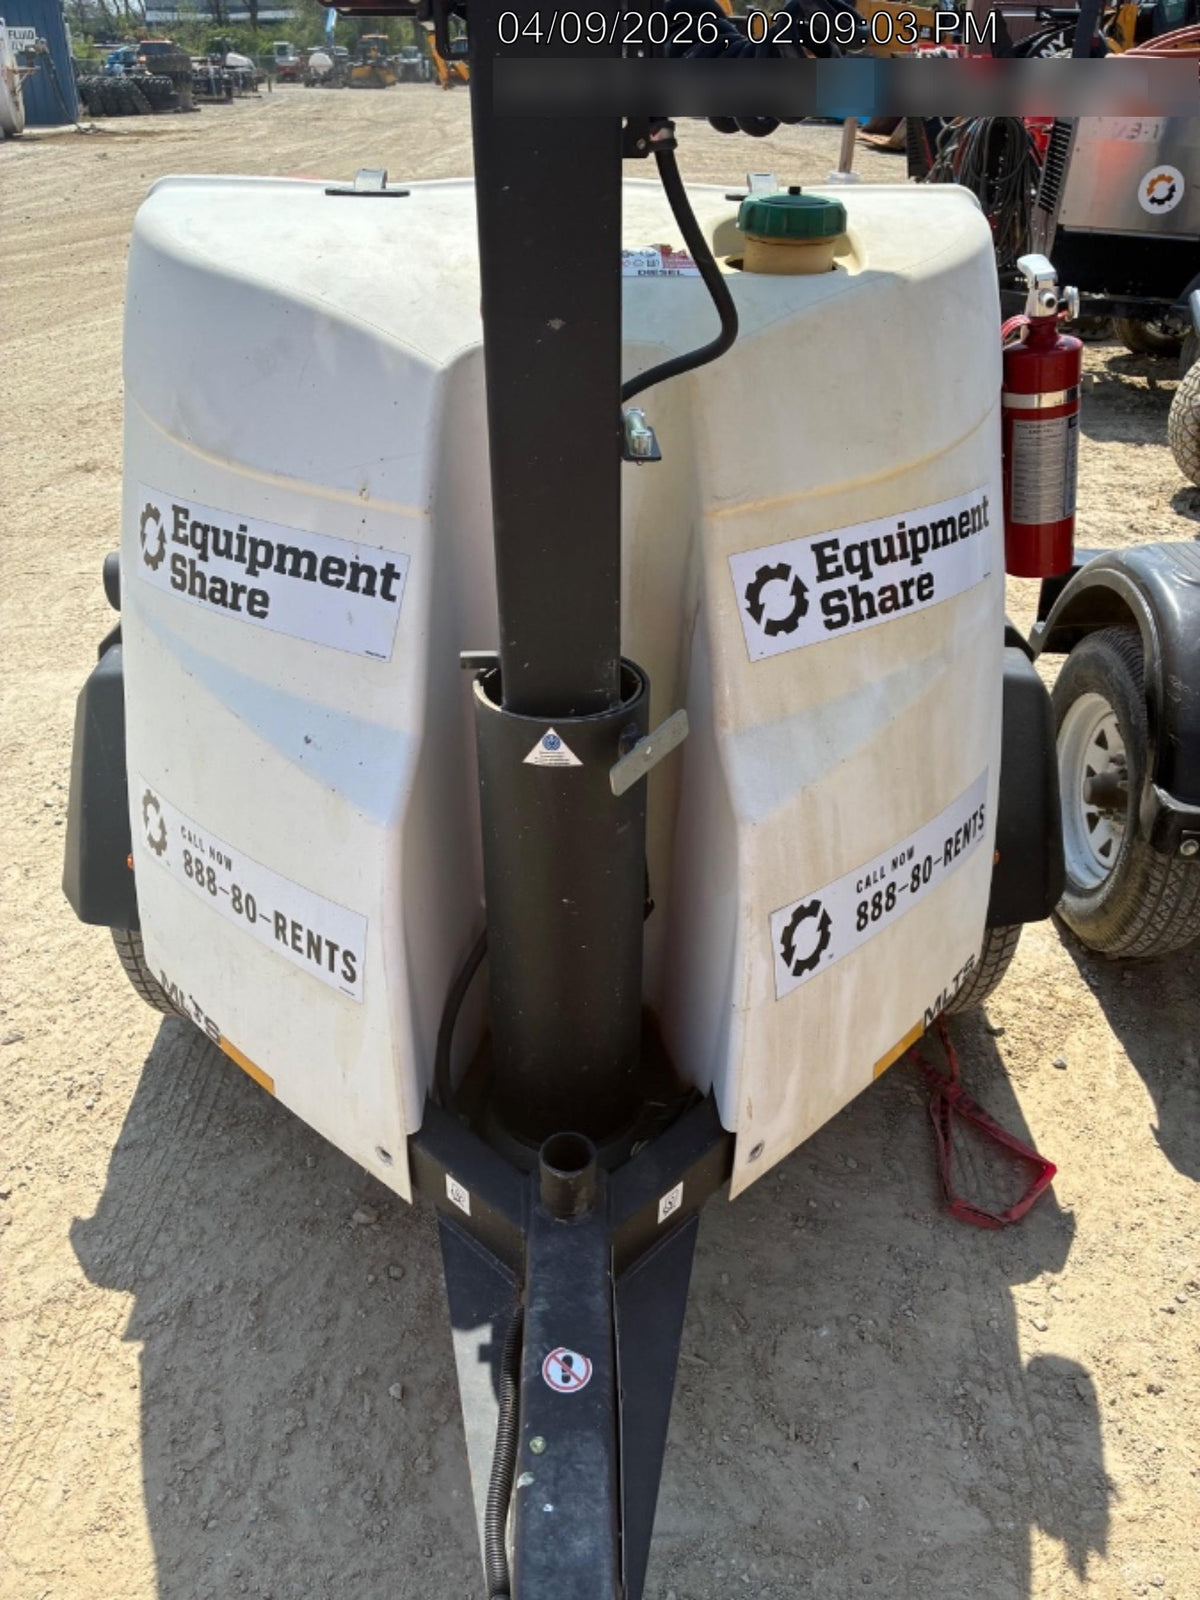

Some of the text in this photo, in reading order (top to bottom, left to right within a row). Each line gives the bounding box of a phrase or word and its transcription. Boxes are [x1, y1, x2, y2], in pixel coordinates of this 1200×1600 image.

[171, 504, 401, 602] Equipment
[810, 495, 989, 583] Equipment
[170, 552, 270, 620] Share
[820, 571, 934, 631] Share
[180, 825, 232, 872] CALL NOW
[856, 803, 985, 932] 888-80-RENTS
[856, 845, 915, 894] CALL NOW
[183, 849, 357, 984] 888-80-RENTS
